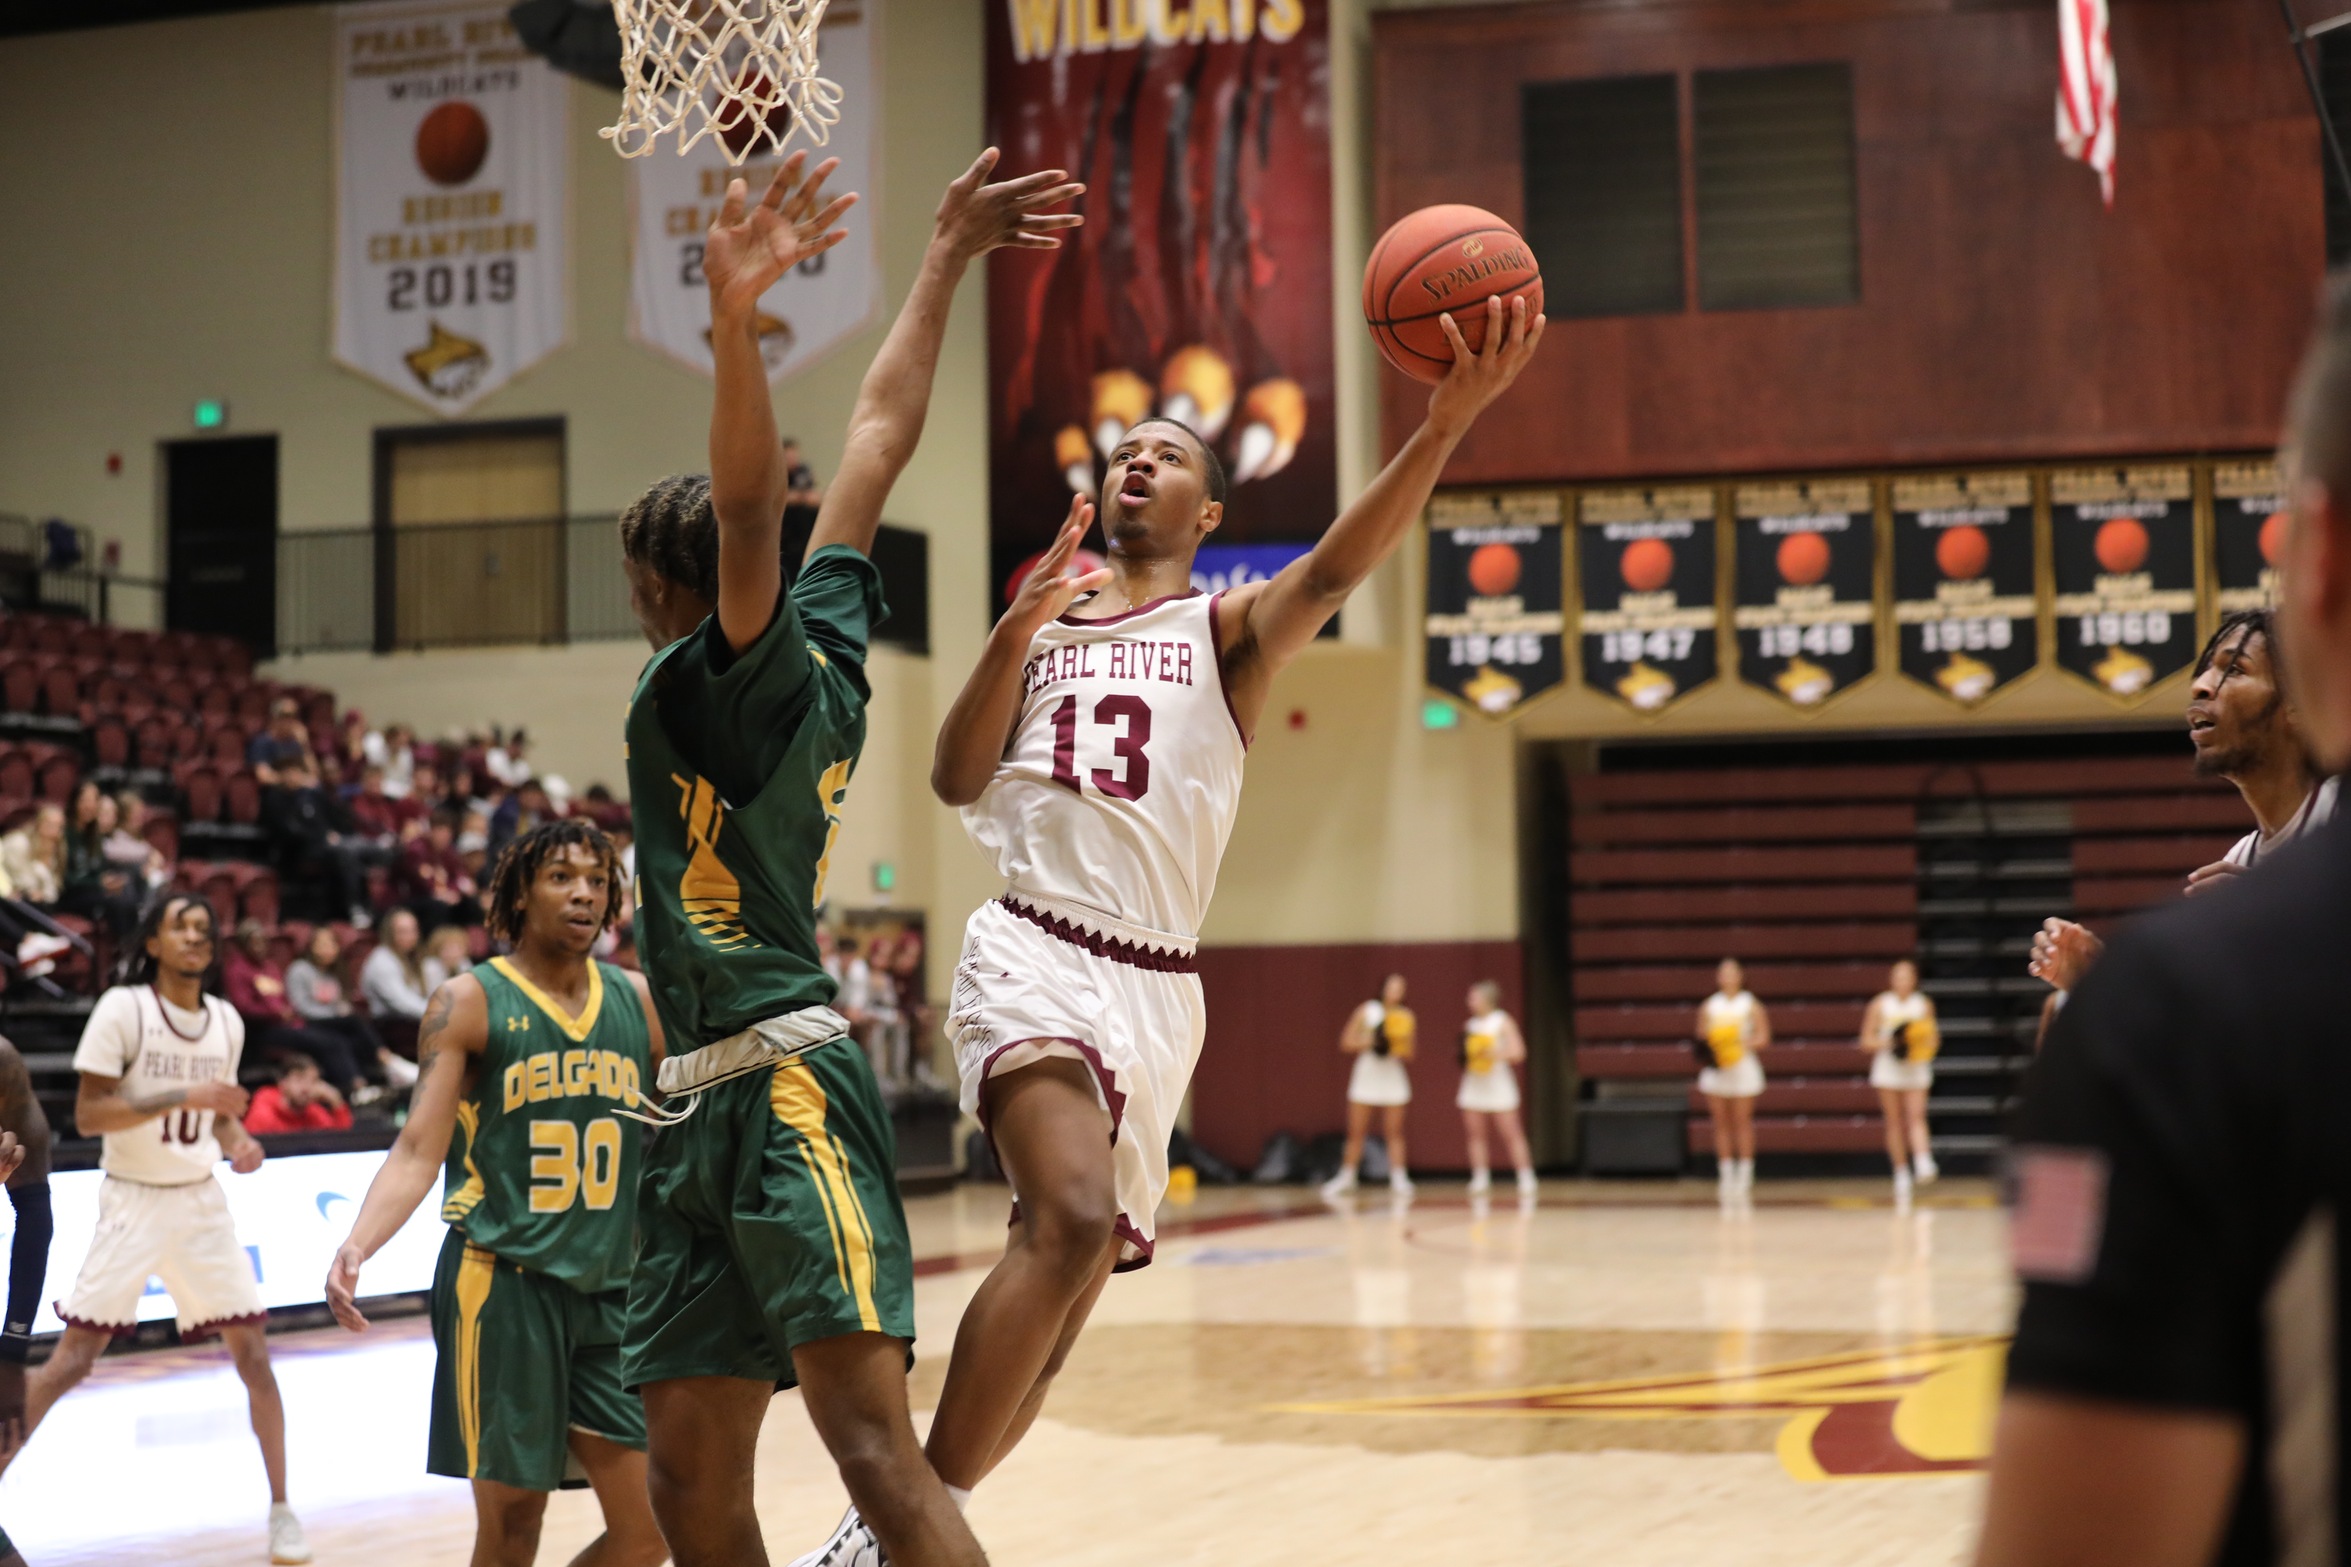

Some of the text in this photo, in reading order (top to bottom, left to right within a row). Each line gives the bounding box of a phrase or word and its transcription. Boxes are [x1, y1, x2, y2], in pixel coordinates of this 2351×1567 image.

[387, 258, 517, 313] 2019
[1420, 246, 1531, 304] SPALDING
[1109, 641, 1193, 686] RIVER
[1602, 628, 1695, 664] 1947
[1050, 694, 1152, 802] 13
[503, 1049, 641, 1115] DELGADO
[529, 1117, 623, 1214] 30
